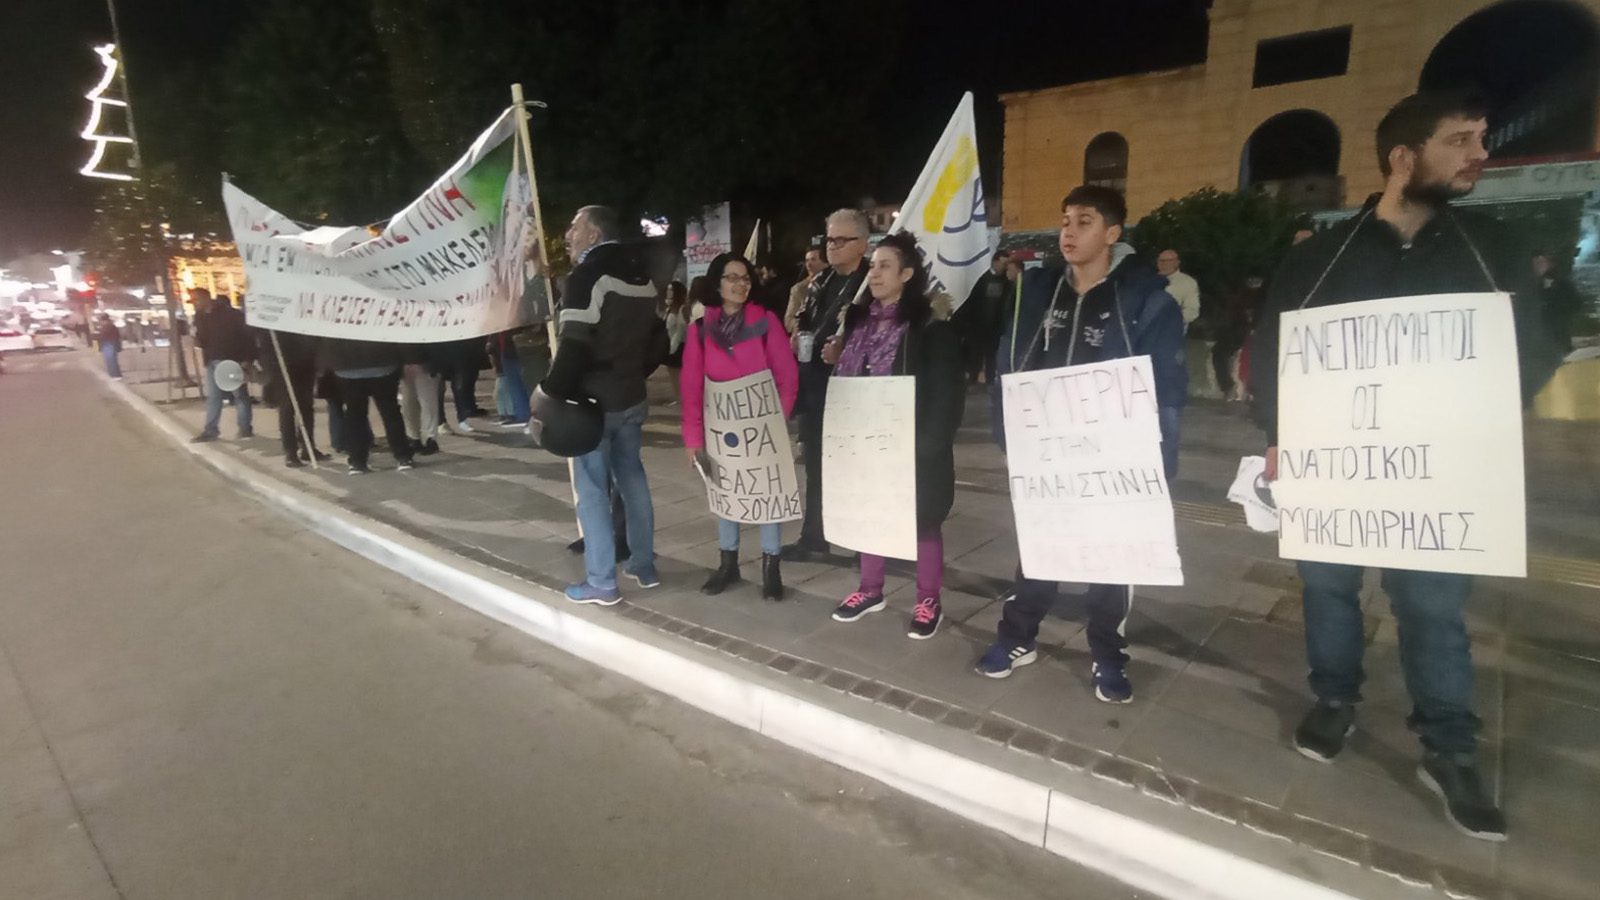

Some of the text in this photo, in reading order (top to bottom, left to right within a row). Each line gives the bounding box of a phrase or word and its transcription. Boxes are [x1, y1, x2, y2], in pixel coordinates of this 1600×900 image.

[1280, 308, 1477, 375] ΑΝΕΠΙΘΥΜΗΤΟΙ
[713, 378, 781, 421] ΚΛΕΙΣΕΙ
[1007, 366, 1156, 428] ΕΥΤΕΡΙΑ
[1352, 383, 1382, 430] ΟΙ
[717, 463, 783, 496] ΒΑΣΗ
[1280, 444, 1433, 481] ΝΑΤΟΙΚΟΙ
[737, 489, 800, 521] ΣΟΥΔΑΣ
